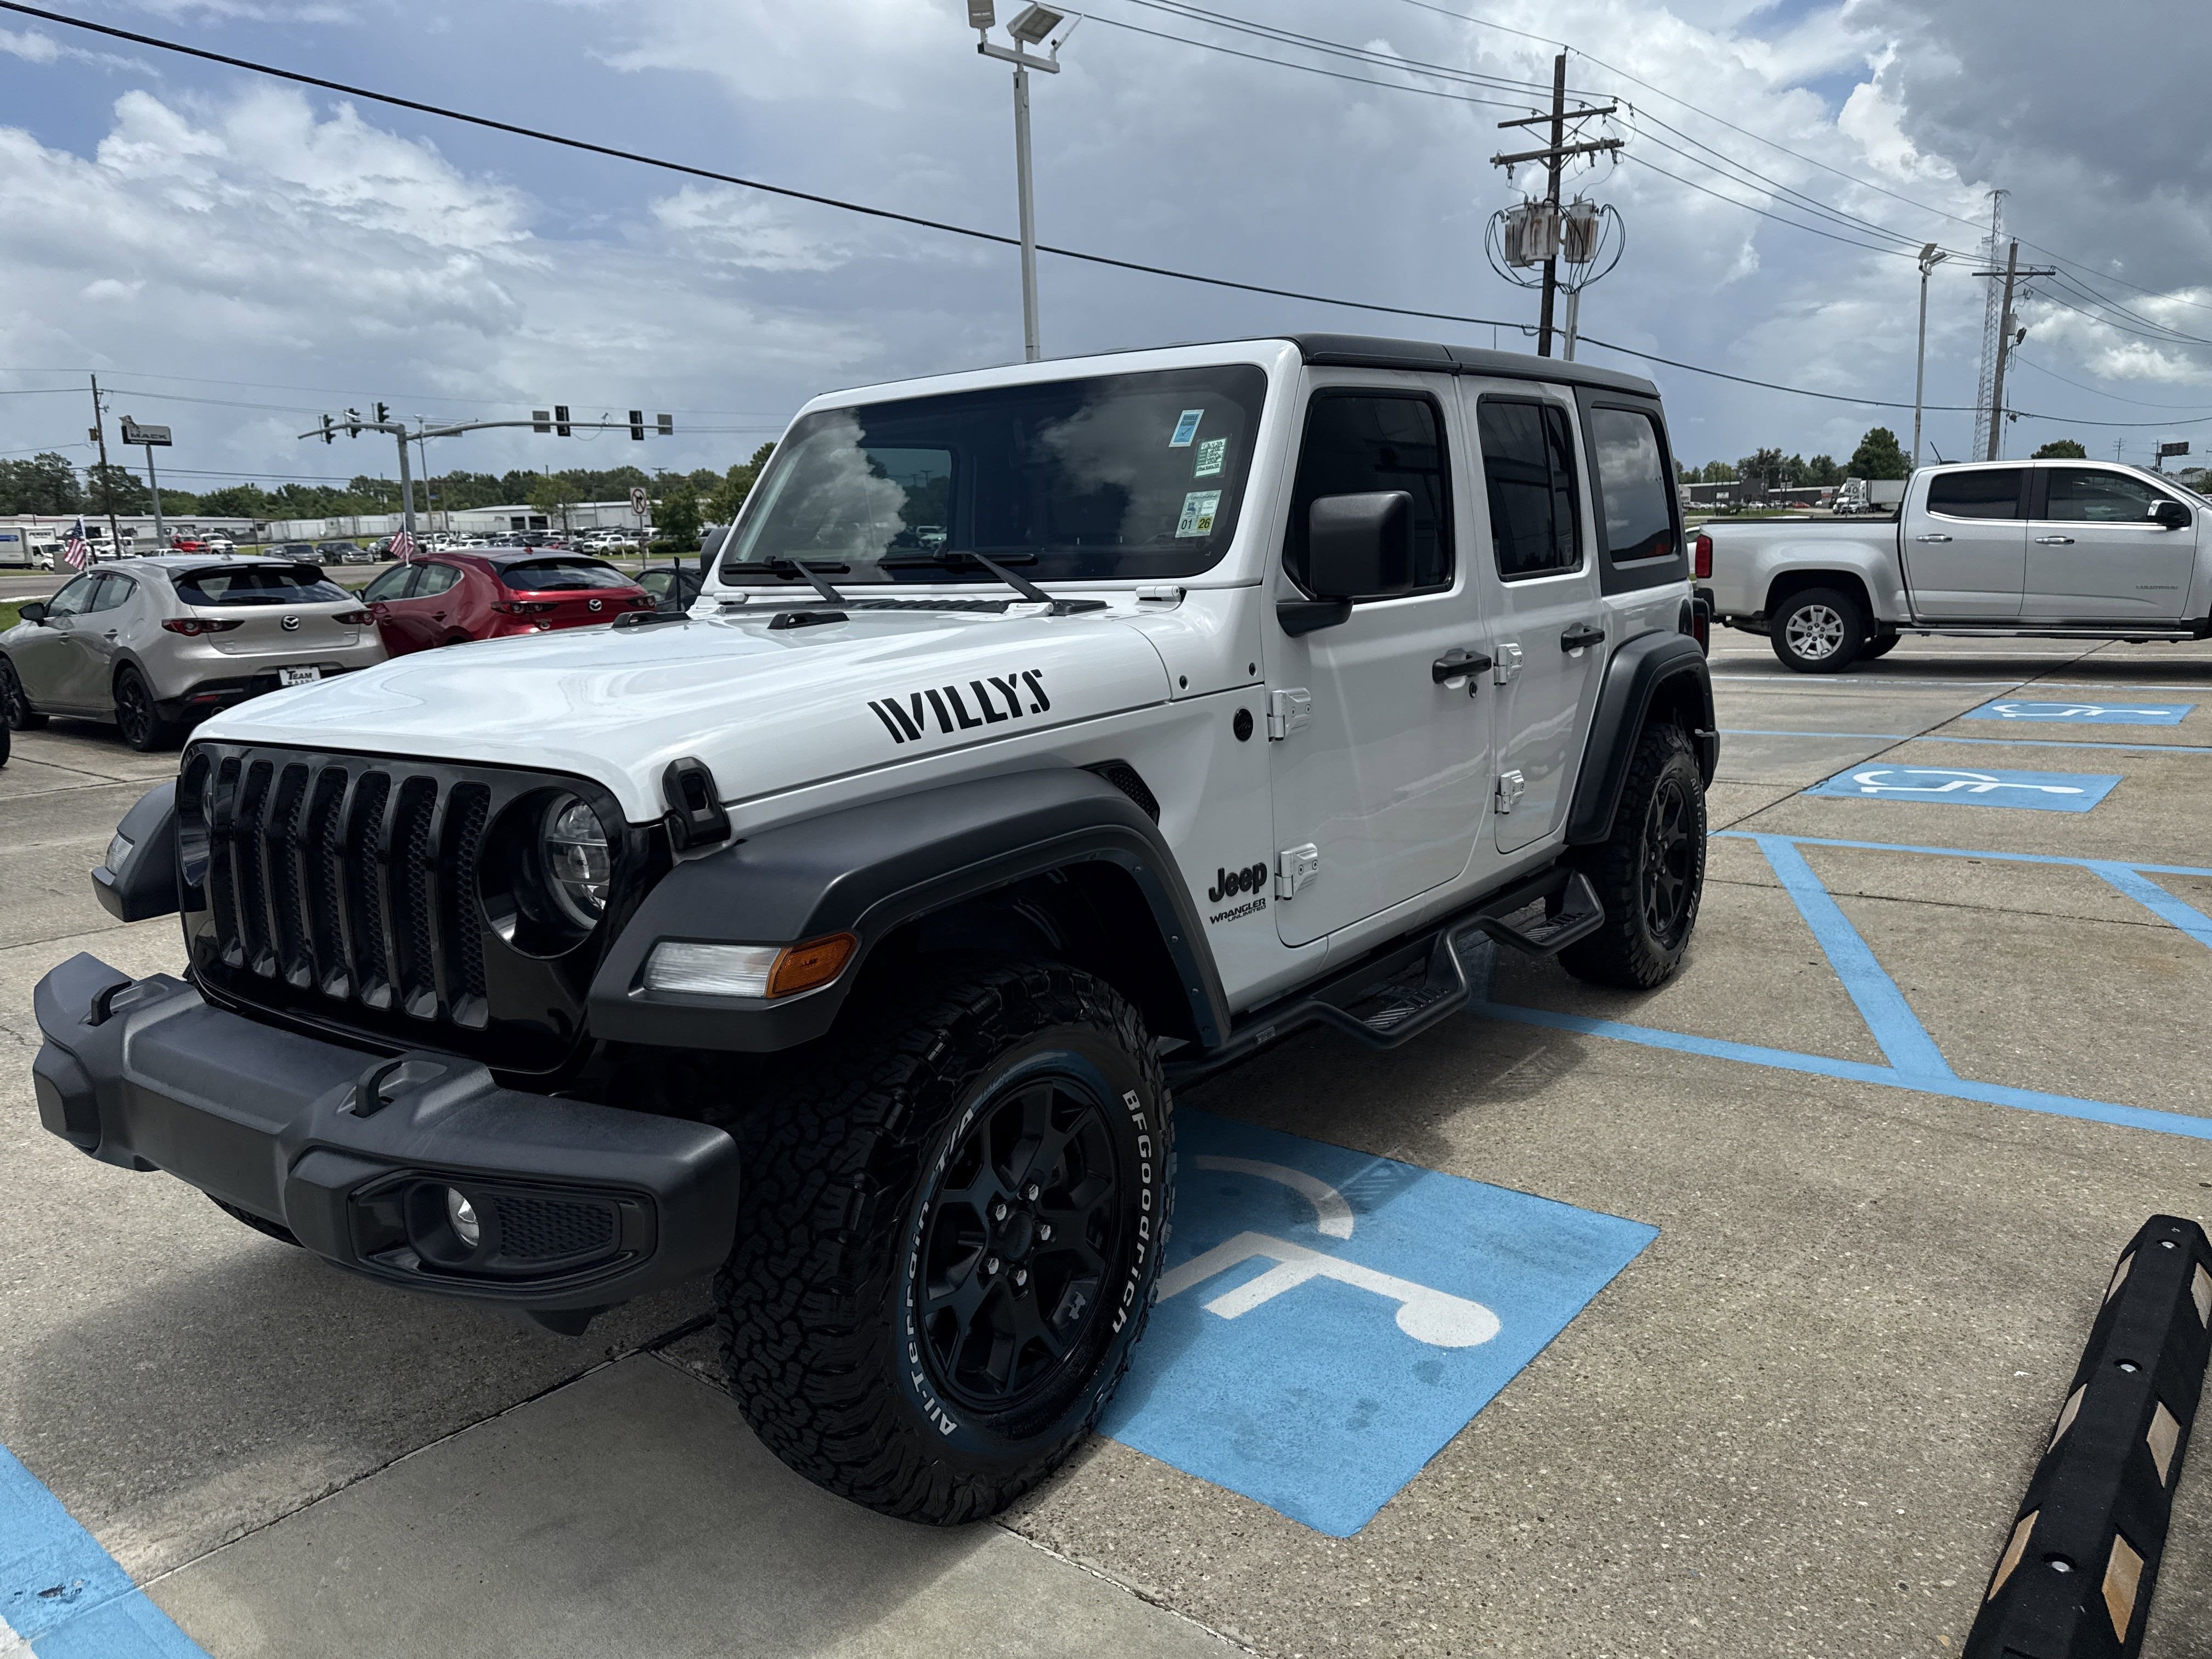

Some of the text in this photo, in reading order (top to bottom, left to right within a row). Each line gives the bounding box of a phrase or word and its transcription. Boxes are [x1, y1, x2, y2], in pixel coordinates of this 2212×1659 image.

[1181, 518, 1211, 530] 01 26
[287, 670, 312, 680] TEAM
[867, 669, 1051, 744] WILLYS
[1209, 862, 1267, 902] Jeep
[1209, 898, 1267, 924] WRANGLER
[1228, 905, 1267, 922] UNLIMITED
[1113, 1089, 1152, 1333] BFGoodrich
[906, 1108, 974, 1436] All-Terrain T/A
